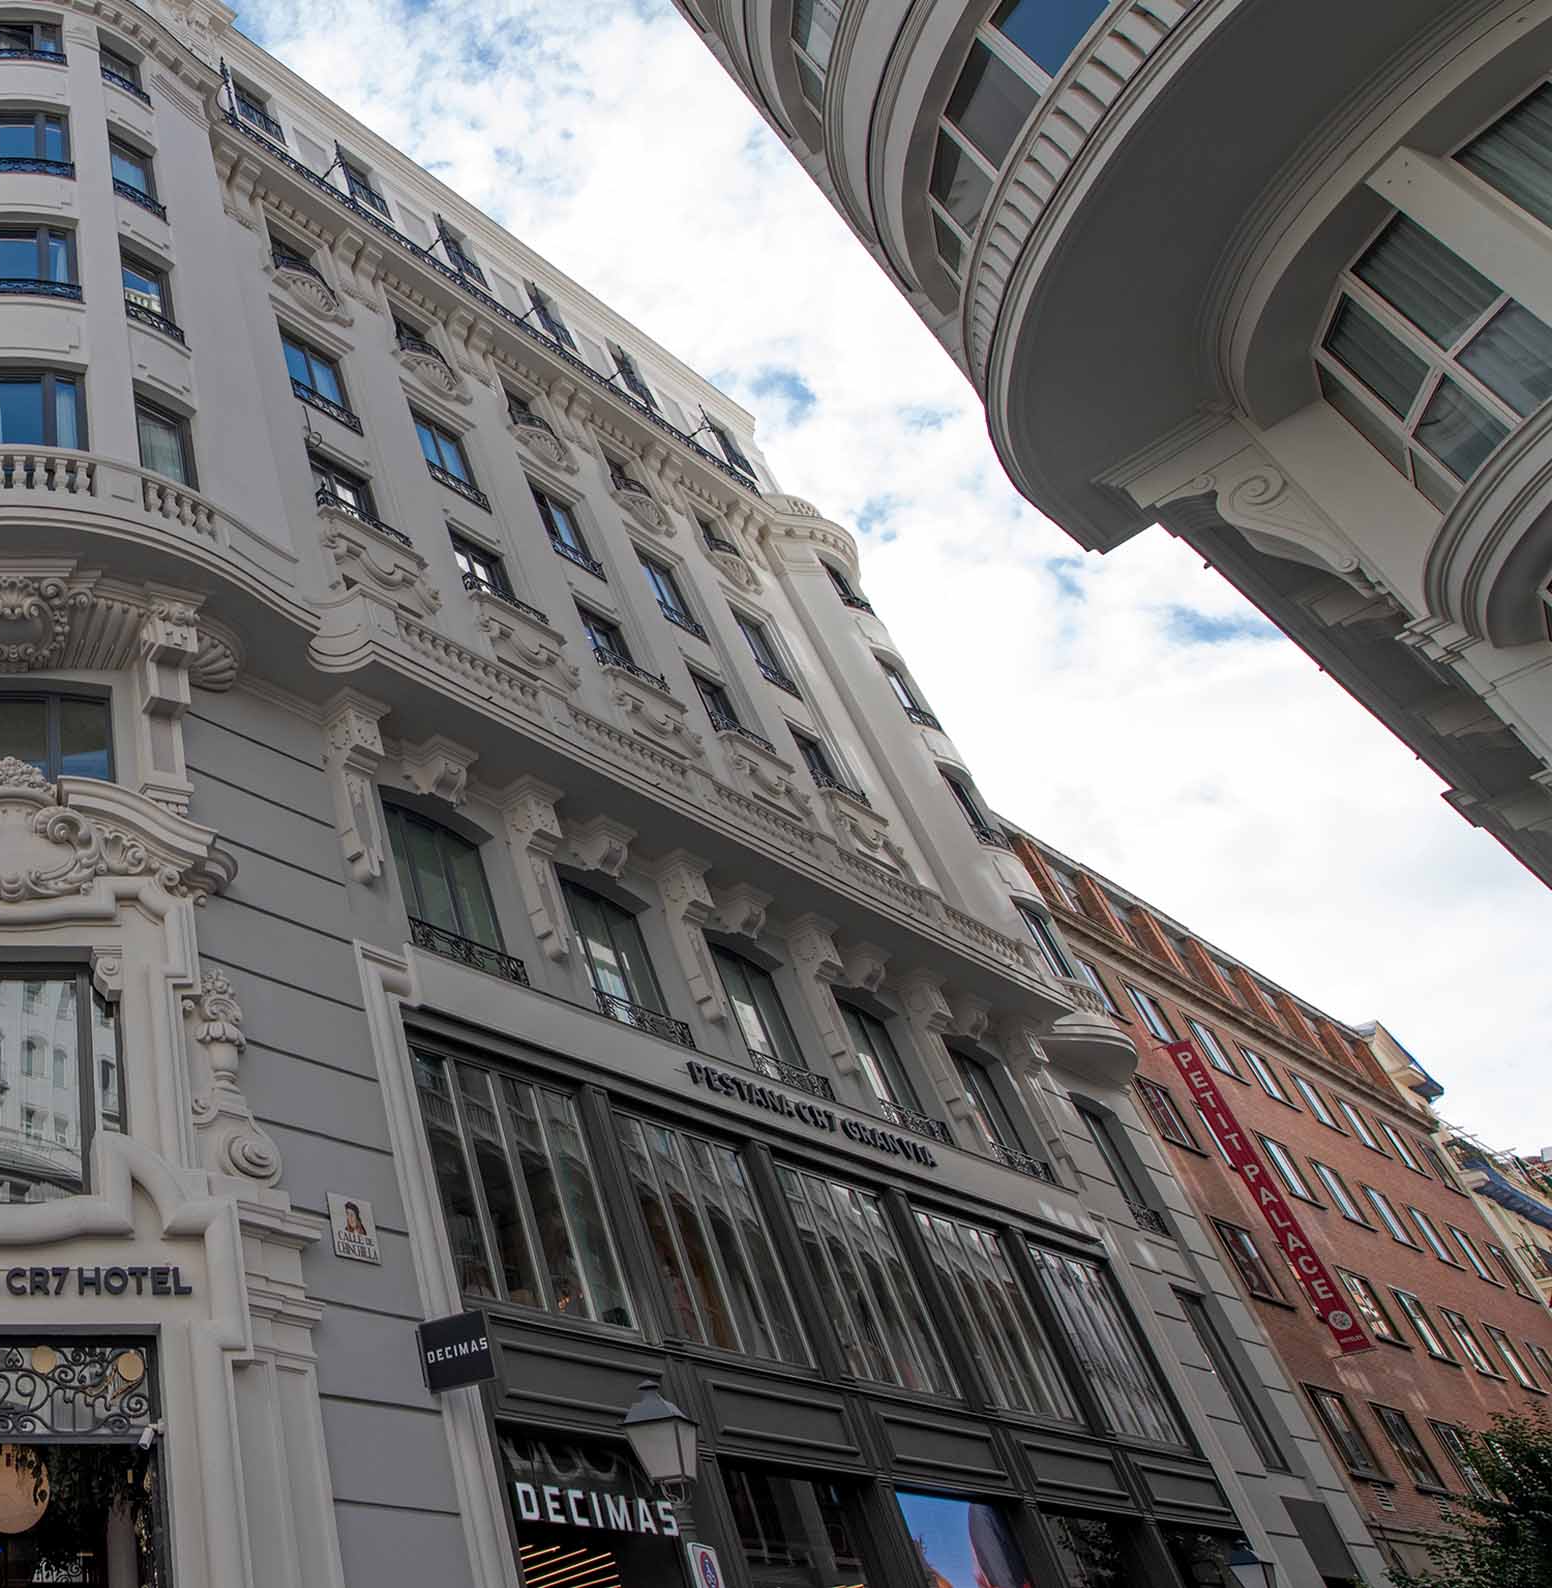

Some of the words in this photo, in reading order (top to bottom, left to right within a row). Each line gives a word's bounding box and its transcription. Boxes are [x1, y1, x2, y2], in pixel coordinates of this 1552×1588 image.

[686, 1060, 795, 1118] PESTANA
[795, 1102, 836, 1133] CR7
[840, 1118, 900, 1155] GRAN
[1176, 1051, 1241, 1148] PETIT
[1243, 1163, 1334, 1300] PALACE
[338, 1230, 365, 1246] CALLE
[6, 1266, 69, 1296] CR7
[77, 1266, 193, 1296] HOTEL
[427, 1337, 489, 1364] DECIMAS
[515, 1481, 680, 1537] DECIMAS
